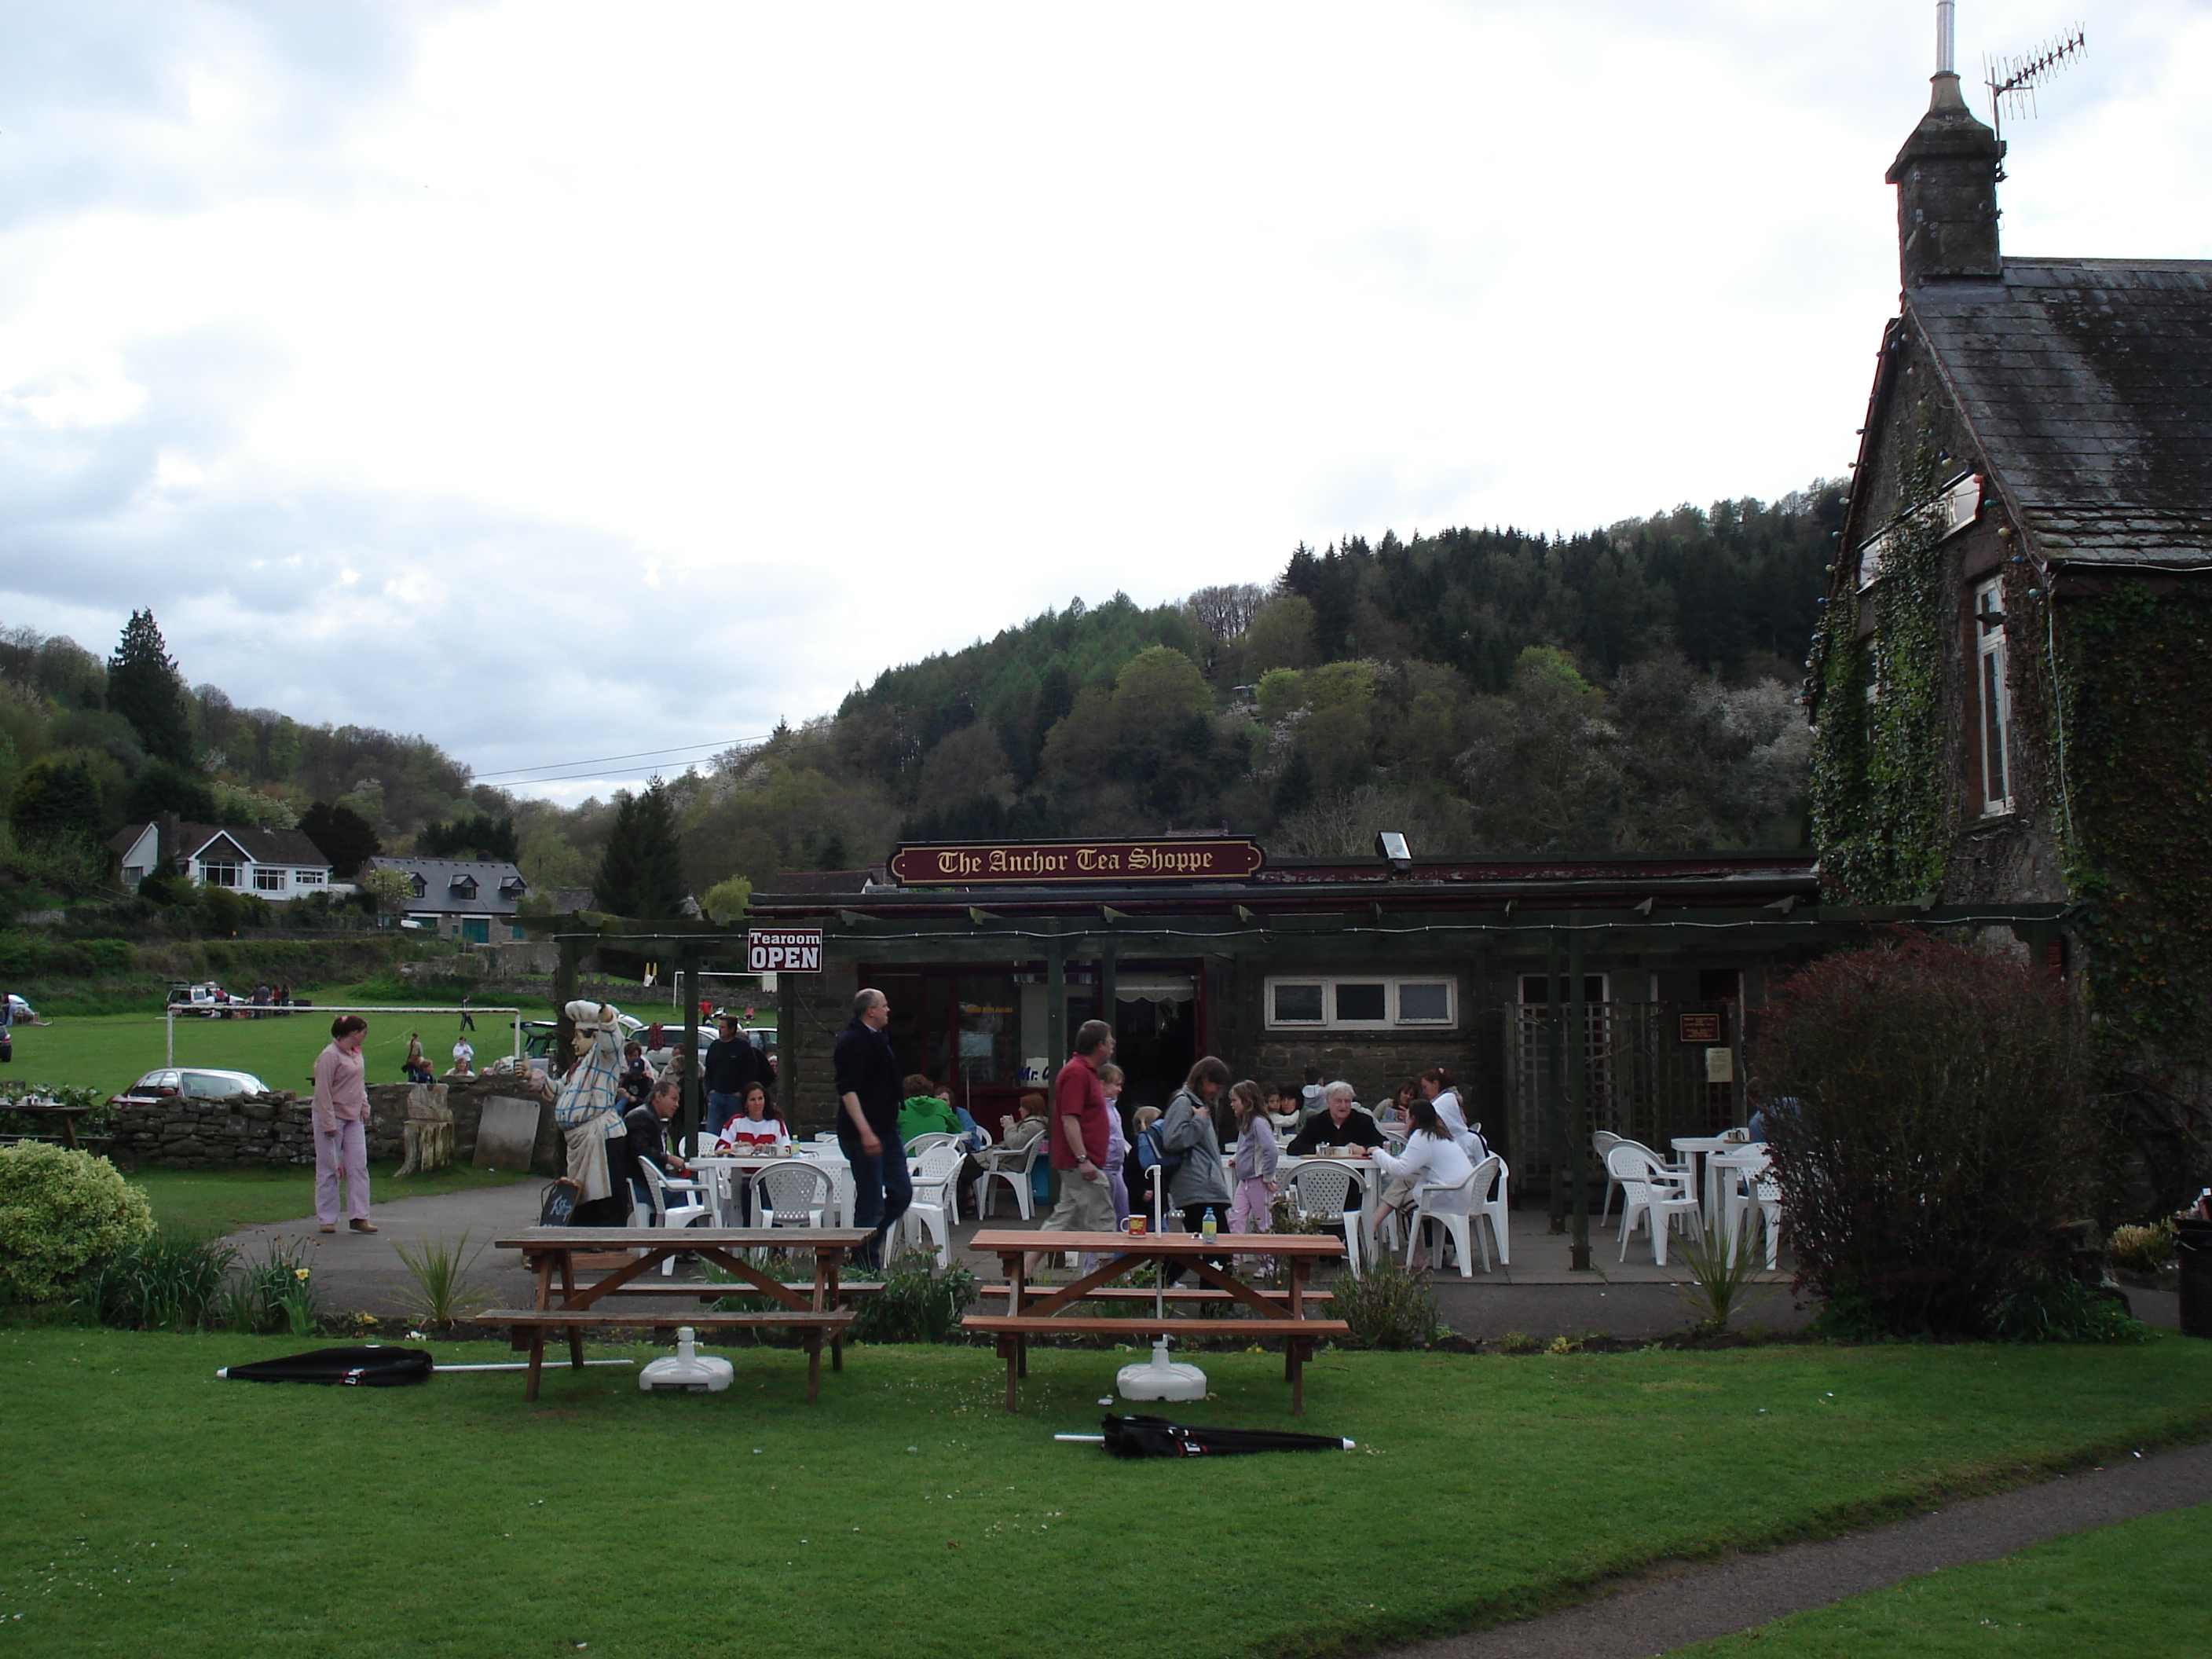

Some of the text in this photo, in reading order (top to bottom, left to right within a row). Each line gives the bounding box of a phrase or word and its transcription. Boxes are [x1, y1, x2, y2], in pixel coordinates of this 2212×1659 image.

[936, 848, 1213, 877] The Anchor Tea Shoppe
[750, 932, 820, 945] Tearoom
[751, 946, 819, 969] OPEN
[1016, 1066, 1038, 1081] Mr.
